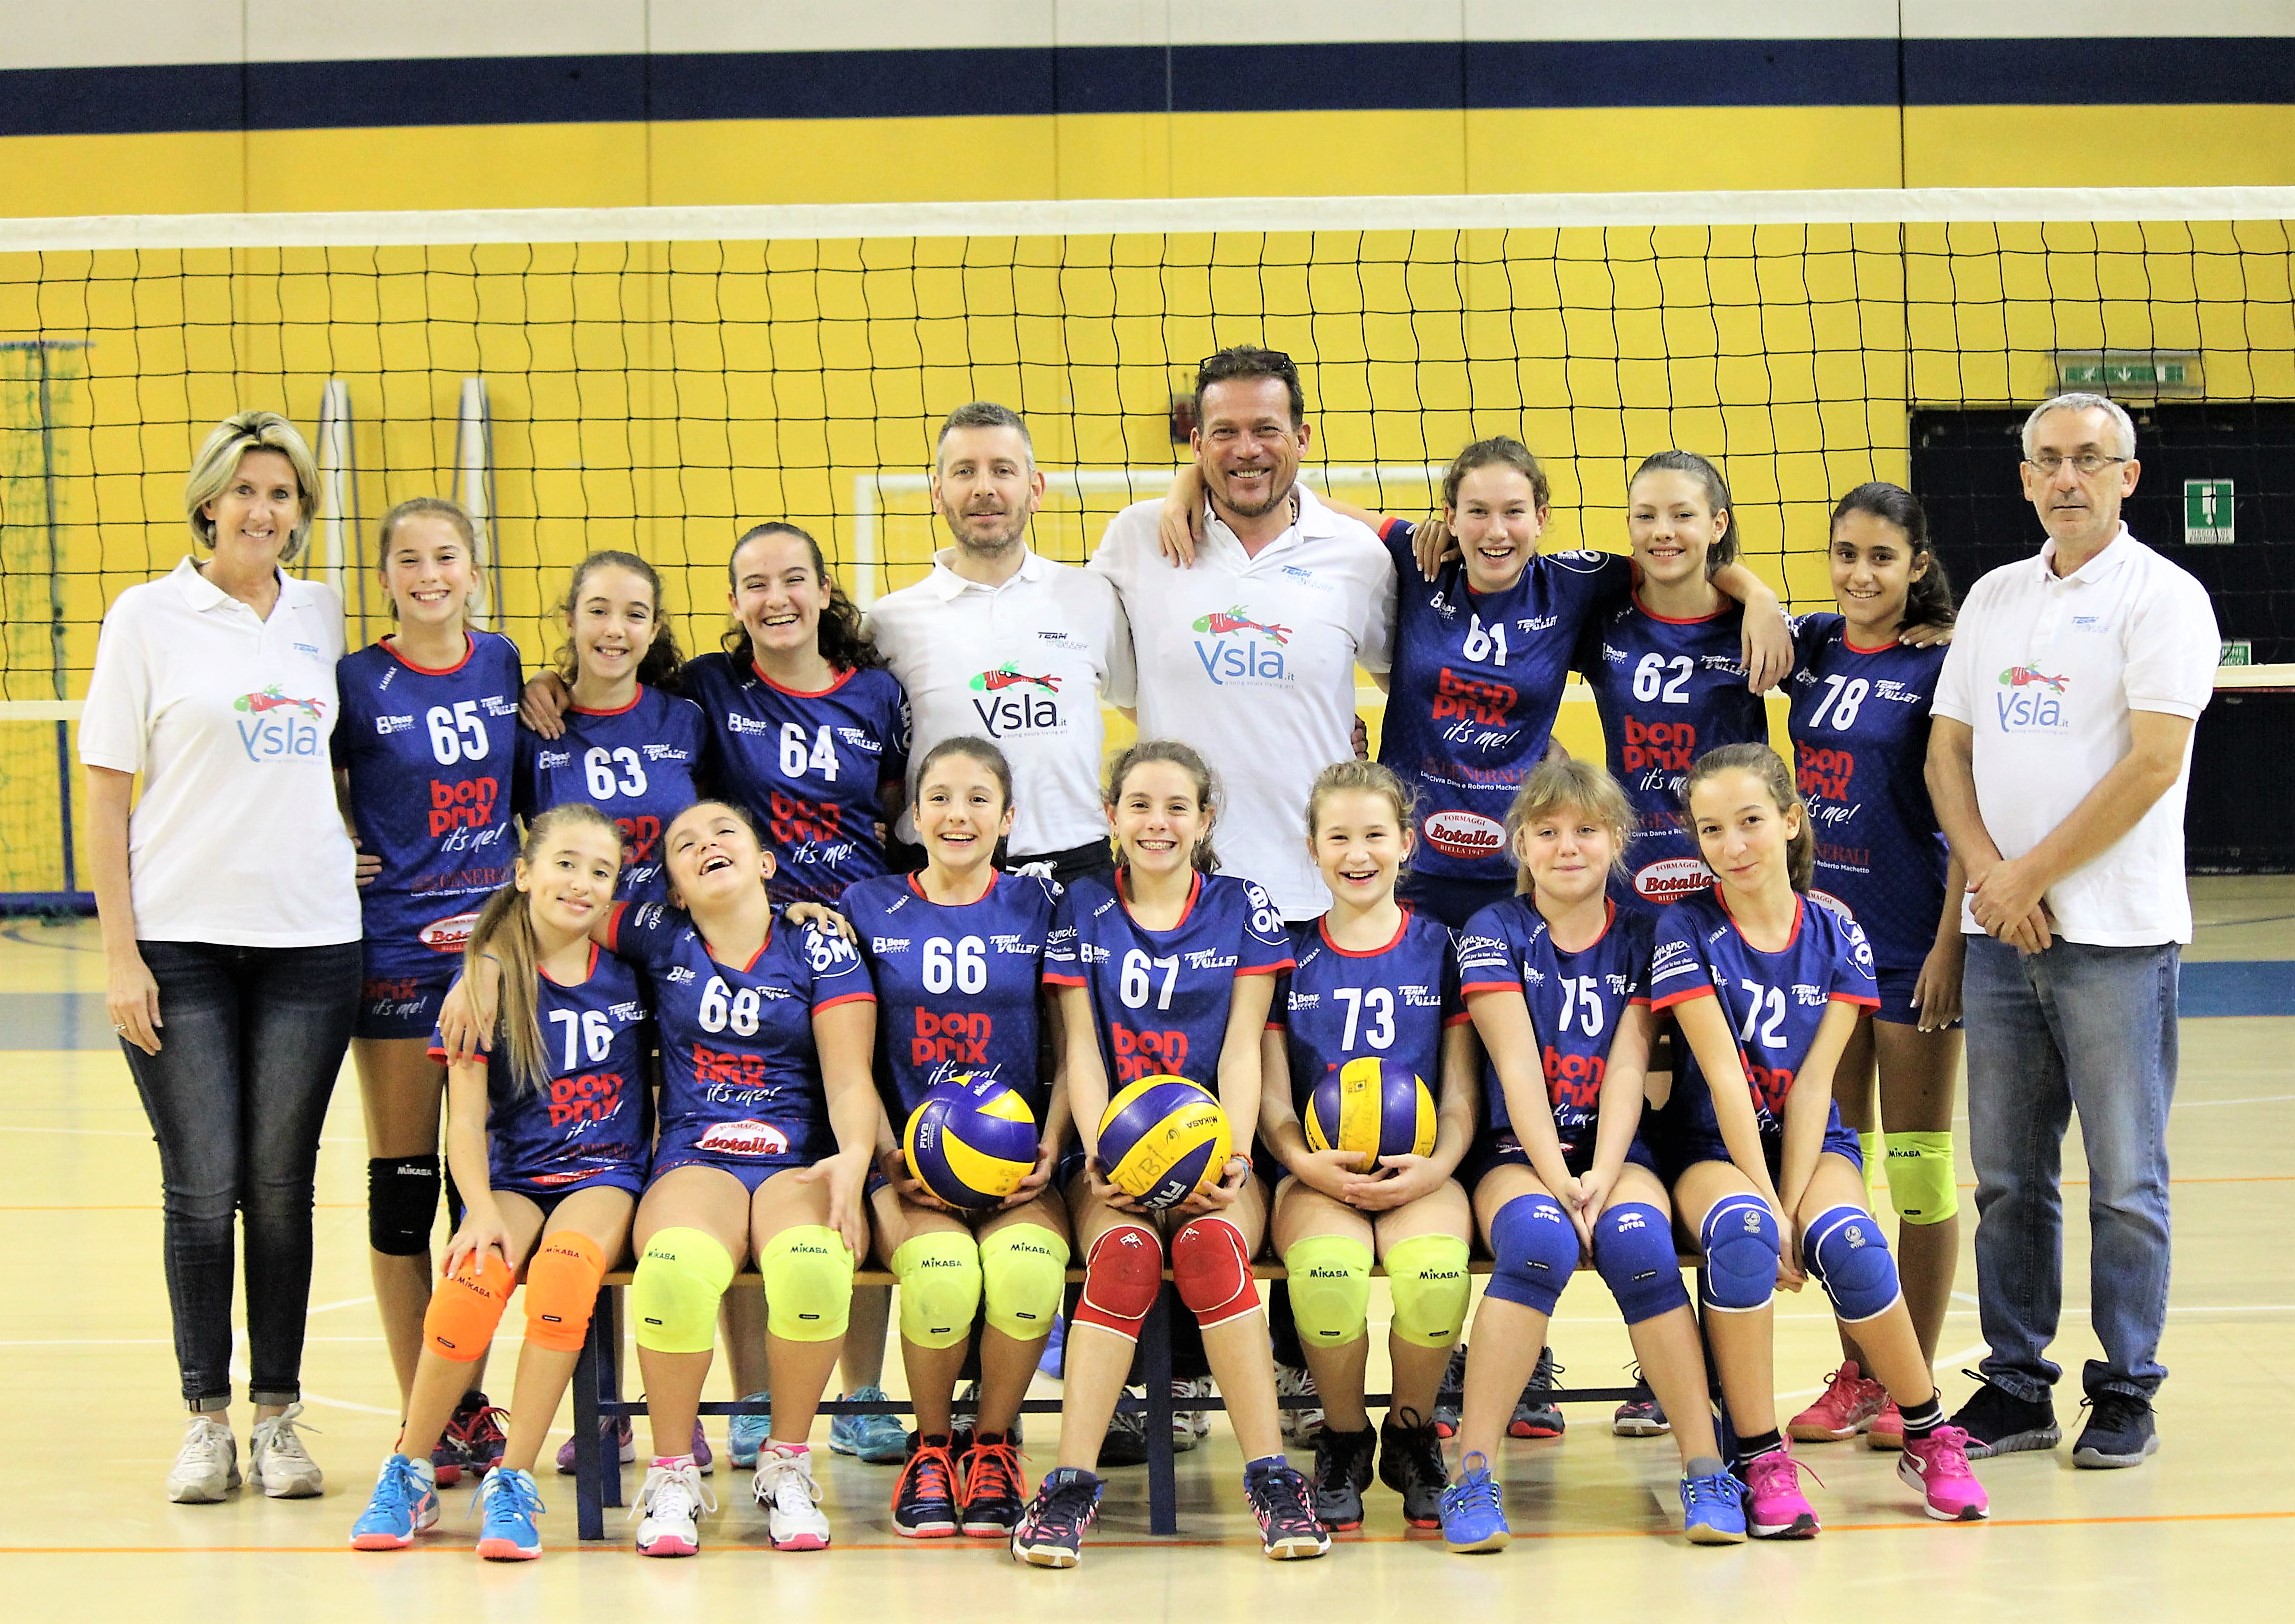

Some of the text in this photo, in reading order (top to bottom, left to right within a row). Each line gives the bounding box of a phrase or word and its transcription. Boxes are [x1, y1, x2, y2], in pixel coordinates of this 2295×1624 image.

[1037, 631, 1069, 640] TEAM
[1462, 613, 1508, 667] 61
[1438, 667, 1519, 713] bon
[1632, 652, 1695, 704] 62
[1431, 693, 1508, 728] prix
[1808, 673, 1870, 732] 78
[425, 700, 490, 766] 65
[1442, 718, 1521, 754] it's me!
[1623, 714, 1697, 748] bon
[779, 722, 840, 782] 64
[1622, 745, 1696, 774] prix
[1797, 739, 1855, 778] bon
[583, 746, 648, 800] 63
[1467, 783, 1495, 791] Roberto
[1495, 784, 1522, 792] Machett
[1796, 766, 1850, 801] prix
[429, 776, 499, 809] bon
[770, 790, 842, 828] bon
[427, 801, 494, 838] prix
[1443, 814, 1486, 827] FORMAGGI
[1820, 803, 1862, 828] me!
[440, 822, 507, 853] it's me!
[1430, 823, 1499, 846] Botalla
[1440, 845, 1466, 855] BIELLA
[792, 840, 857, 869] it's me!
[1655, 862, 1699, 872] FORMAGGI
[1643, 872, 1715, 892] Botalla
[989, 934, 1021, 945] TEAM
[922, 935, 987, 995] 66
[1119, 948, 1181, 1011] 67
[698, 975, 760, 1037] 68
[1398, 985, 1429, 996] TEAM
[1557, 972, 1605, 1037] 75
[1791, 984, 1821, 996] TEAM
[914, 1006, 993, 1039] bon
[1333, 986, 1396, 1052] 73
[1740, 978, 1788, 1049] 72
[548, 1008, 615, 1071] 76
[911, 1037, 990, 1067] prix
[1111, 1022, 1189, 1057] bon
